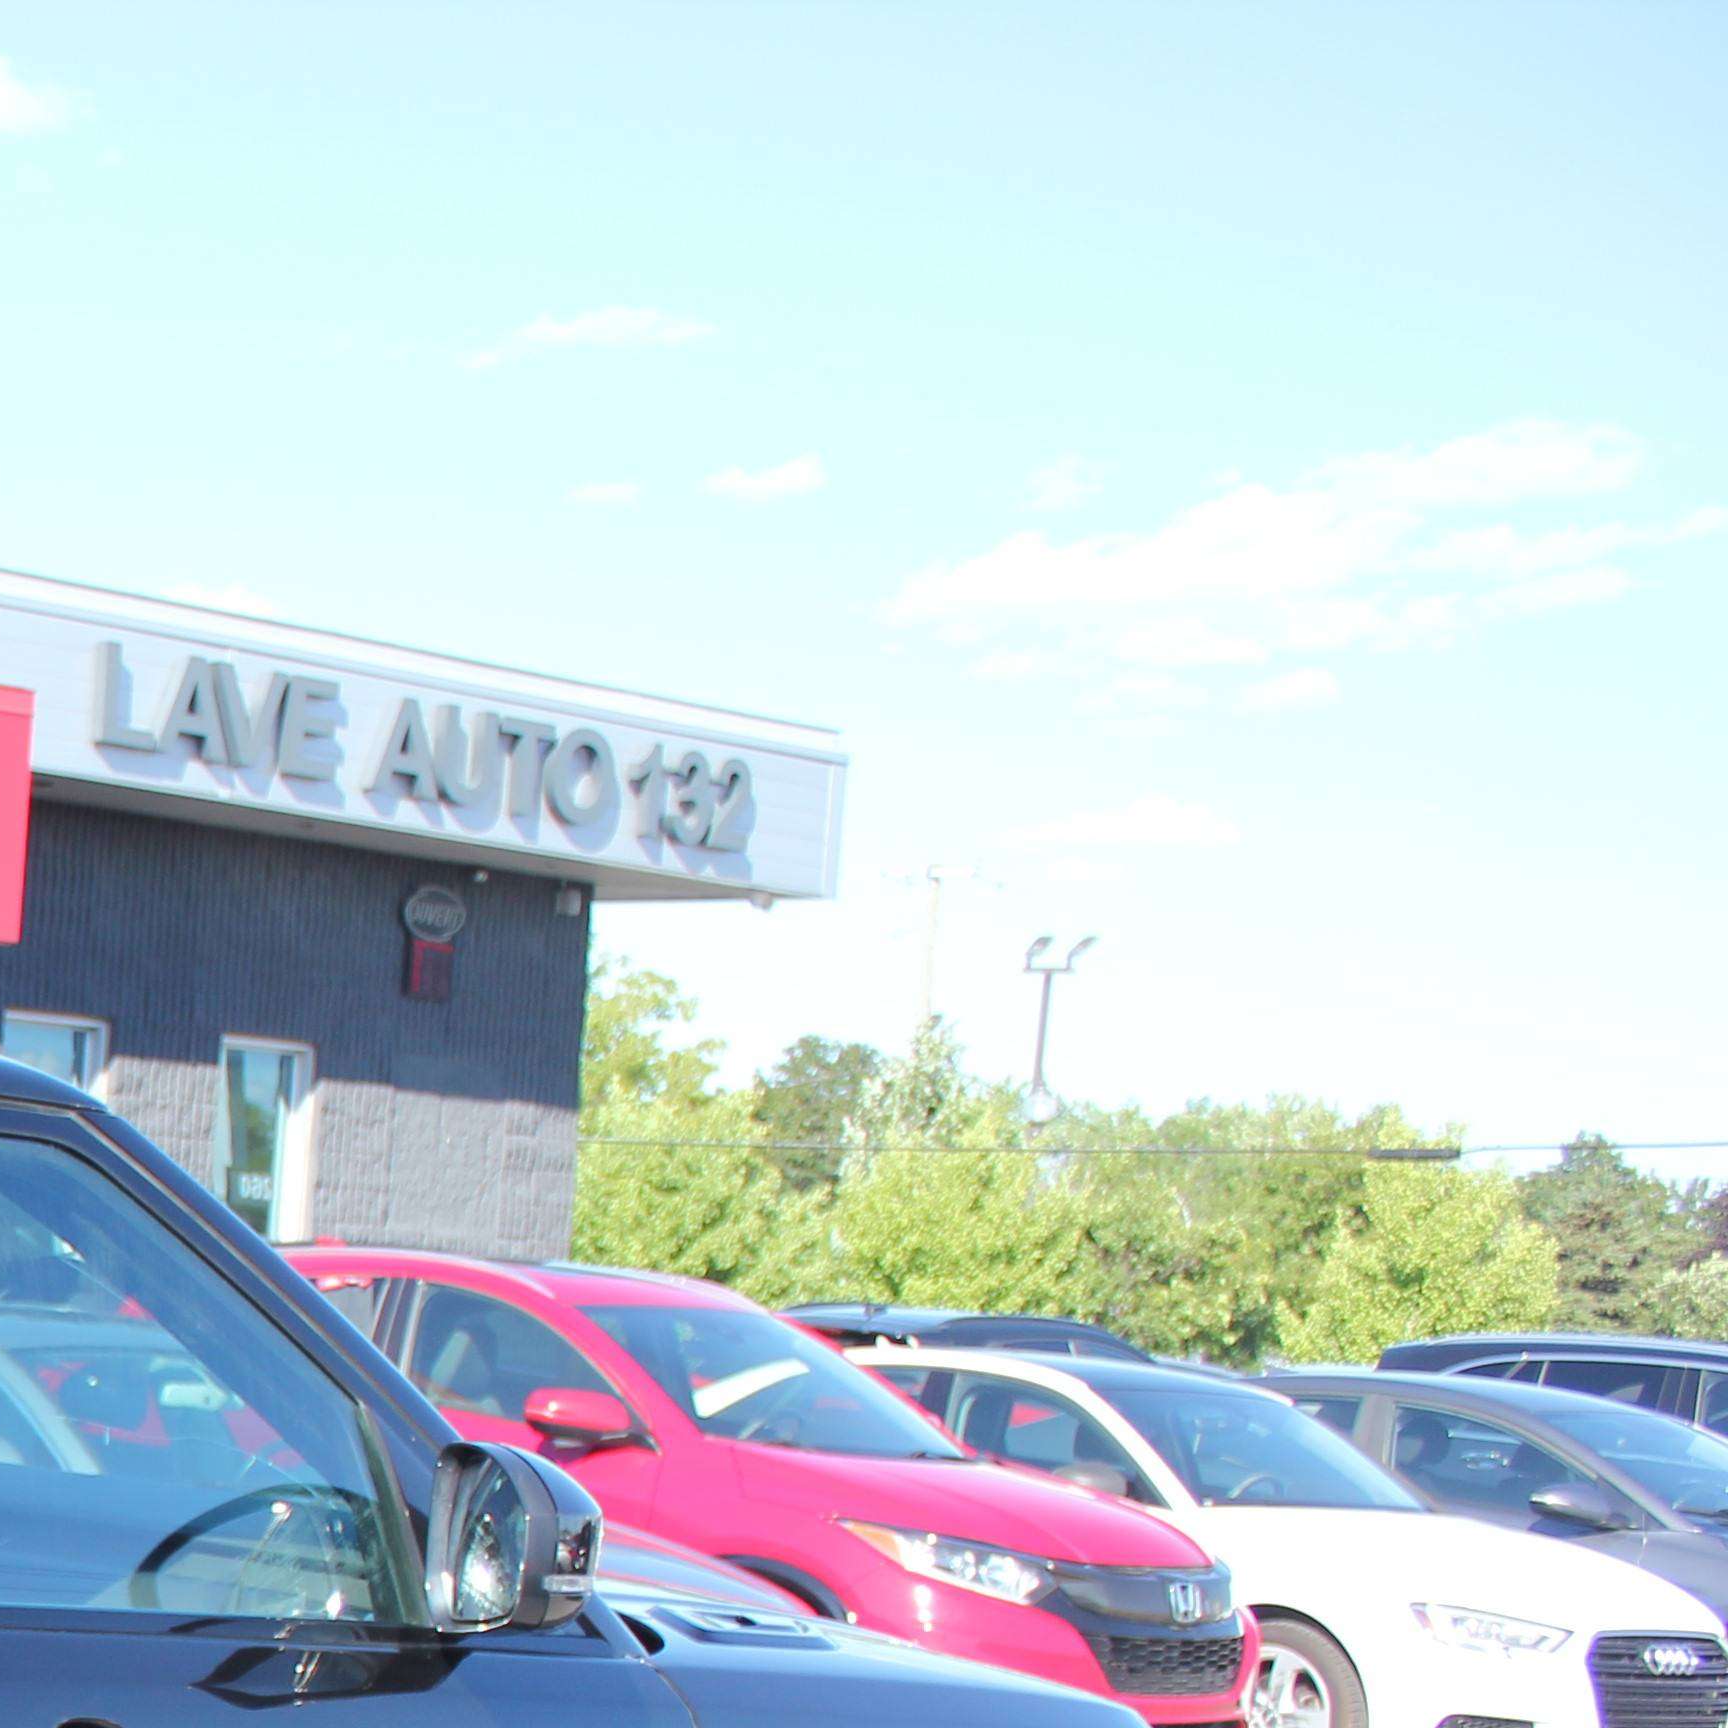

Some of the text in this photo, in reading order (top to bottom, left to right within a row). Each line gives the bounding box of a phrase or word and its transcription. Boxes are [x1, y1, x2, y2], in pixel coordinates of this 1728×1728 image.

[93, 641, 754, 852] LAVE AUTO 132
